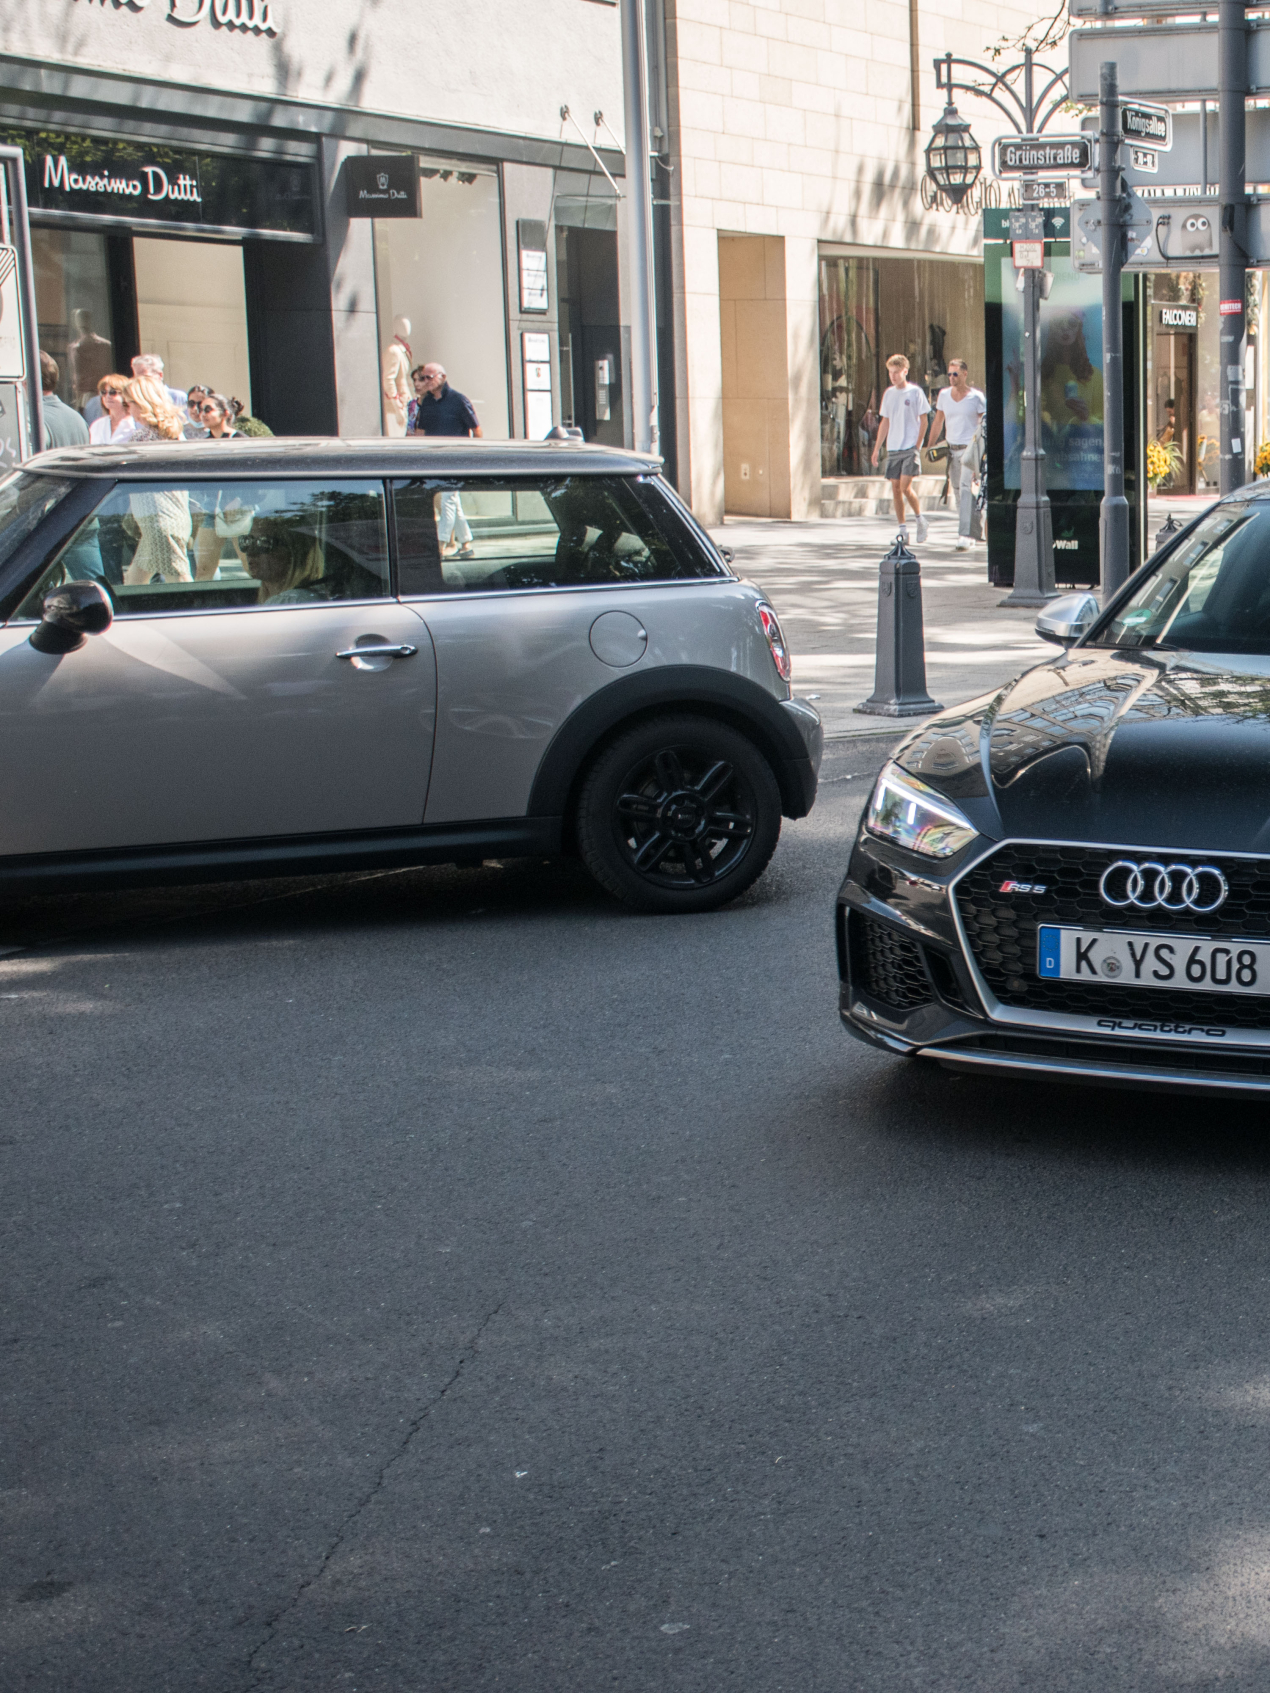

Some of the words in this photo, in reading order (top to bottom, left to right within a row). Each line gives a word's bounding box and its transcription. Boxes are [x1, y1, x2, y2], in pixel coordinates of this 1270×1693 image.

[1127, 110, 1165, 137] Königsallee
[1006, 145, 1080, 166] Grünstraße
[44, 154, 142, 196] Massimo
[140, 165, 202, 202] Dutti
[359, 190, 389, 199] Massimo
[390, 189, 408, 199] Dutti
[1032, 184, 1057, 197] 26-5
[1162, 308, 1197, 327] FALCONERI
[1056, 539, 1079, 550] Wall
[1075, 936, 1099, 976] K
[1096, 1019, 1227, 1038] quattro
